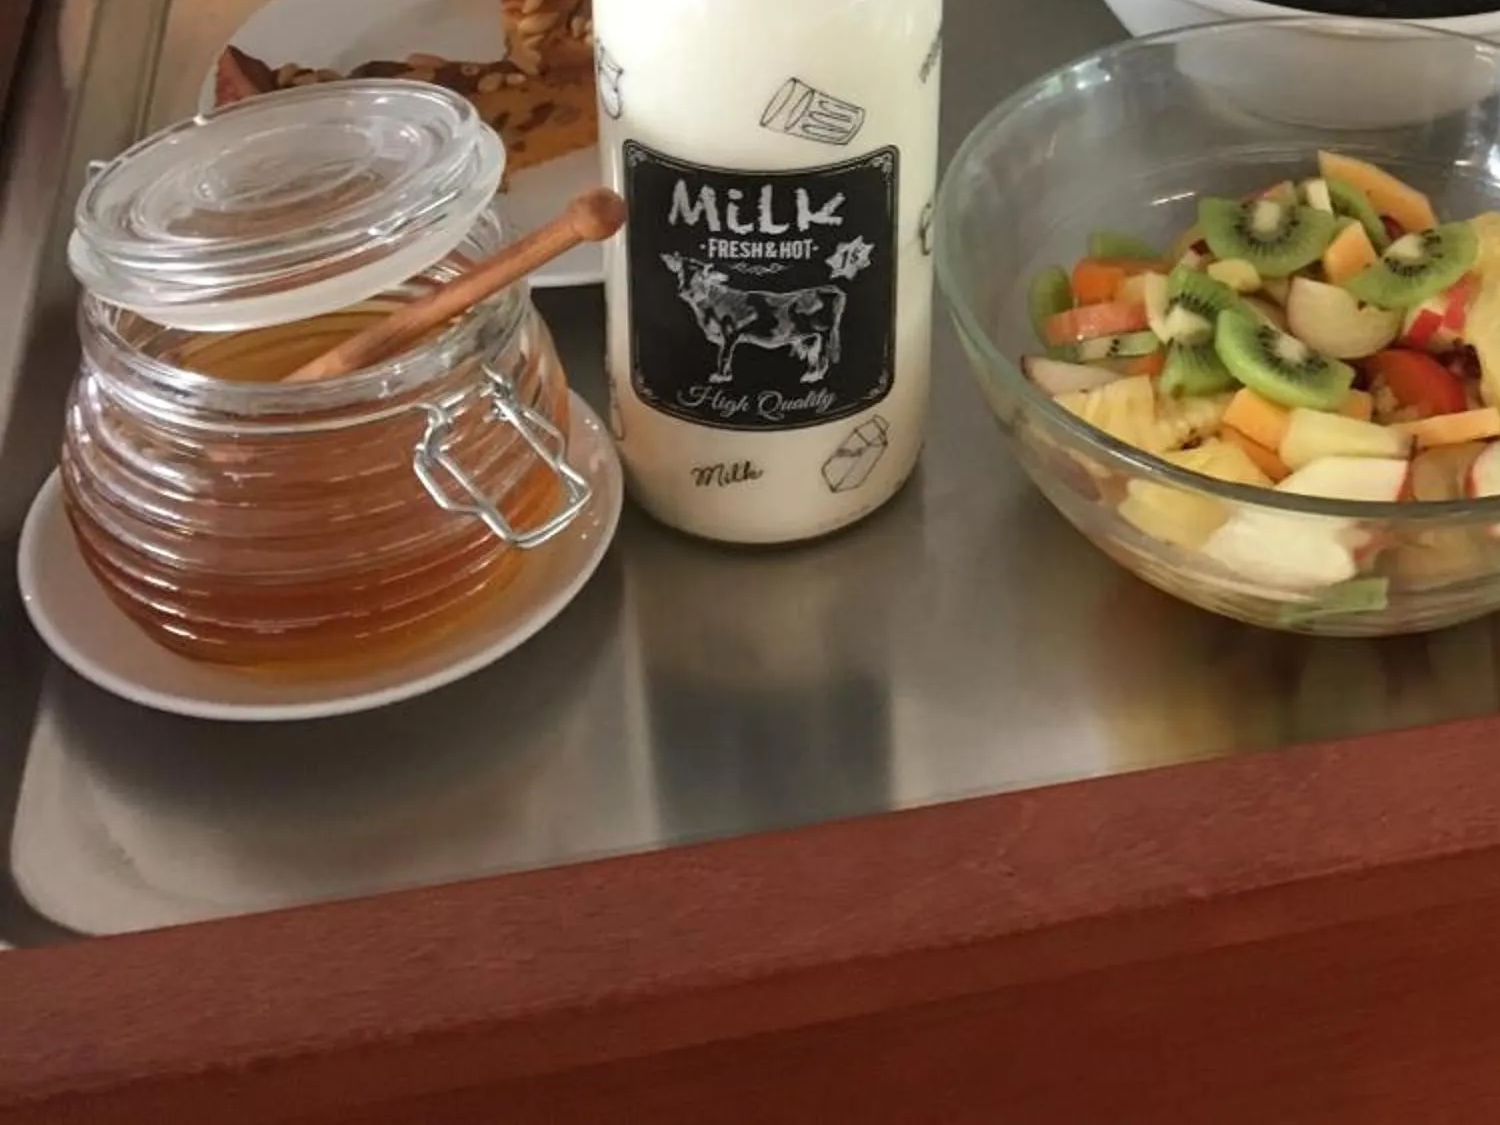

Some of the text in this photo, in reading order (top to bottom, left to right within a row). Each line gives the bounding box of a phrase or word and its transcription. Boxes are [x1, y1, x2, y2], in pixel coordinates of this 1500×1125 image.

[676, 385, 836, 421] High Quality
[690, 460, 764, 487] Milk
